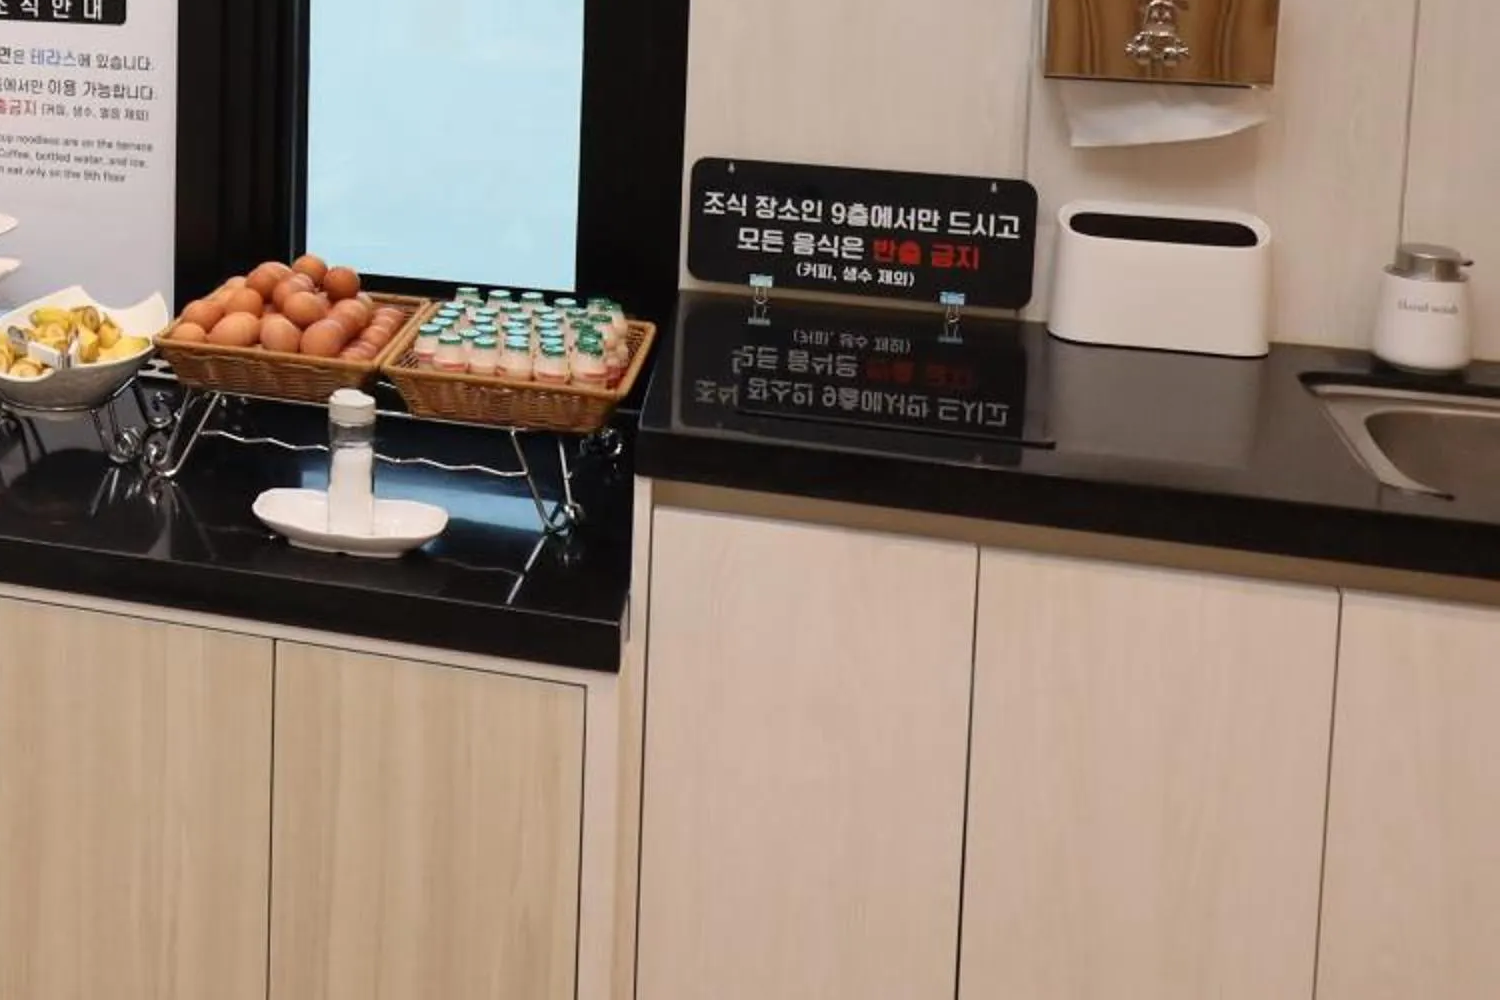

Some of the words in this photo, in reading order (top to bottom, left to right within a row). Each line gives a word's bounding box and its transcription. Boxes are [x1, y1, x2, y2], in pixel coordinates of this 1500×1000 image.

[30, 47, 91, 68] 테라스에
[47, 79, 76, 97] 이용
[97, 138, 113, 150] the
[35, 151, 71, 163] bottled
[109, 157, 128, 168] and
[7, 166, 23, 177] eat
[25, 167, 48, 179] only
[703, 191, 748, 217] 조식
[755, 195, 824, 224] 장소인
[831, 201, 941, 233] 9층에서만
[947, 211, 1021, 240] 드시고
[737, 227, 785, 254] 모든
[792, 231, 866, 261] 음식은
[872, 239, 922, 266] 반출
[931, 243, 980, 271] 금지
[796, 262, 838, 281] (커피,
[843, 266, 873, 284] 생수
[877, 268, 916, 288] 제외)
